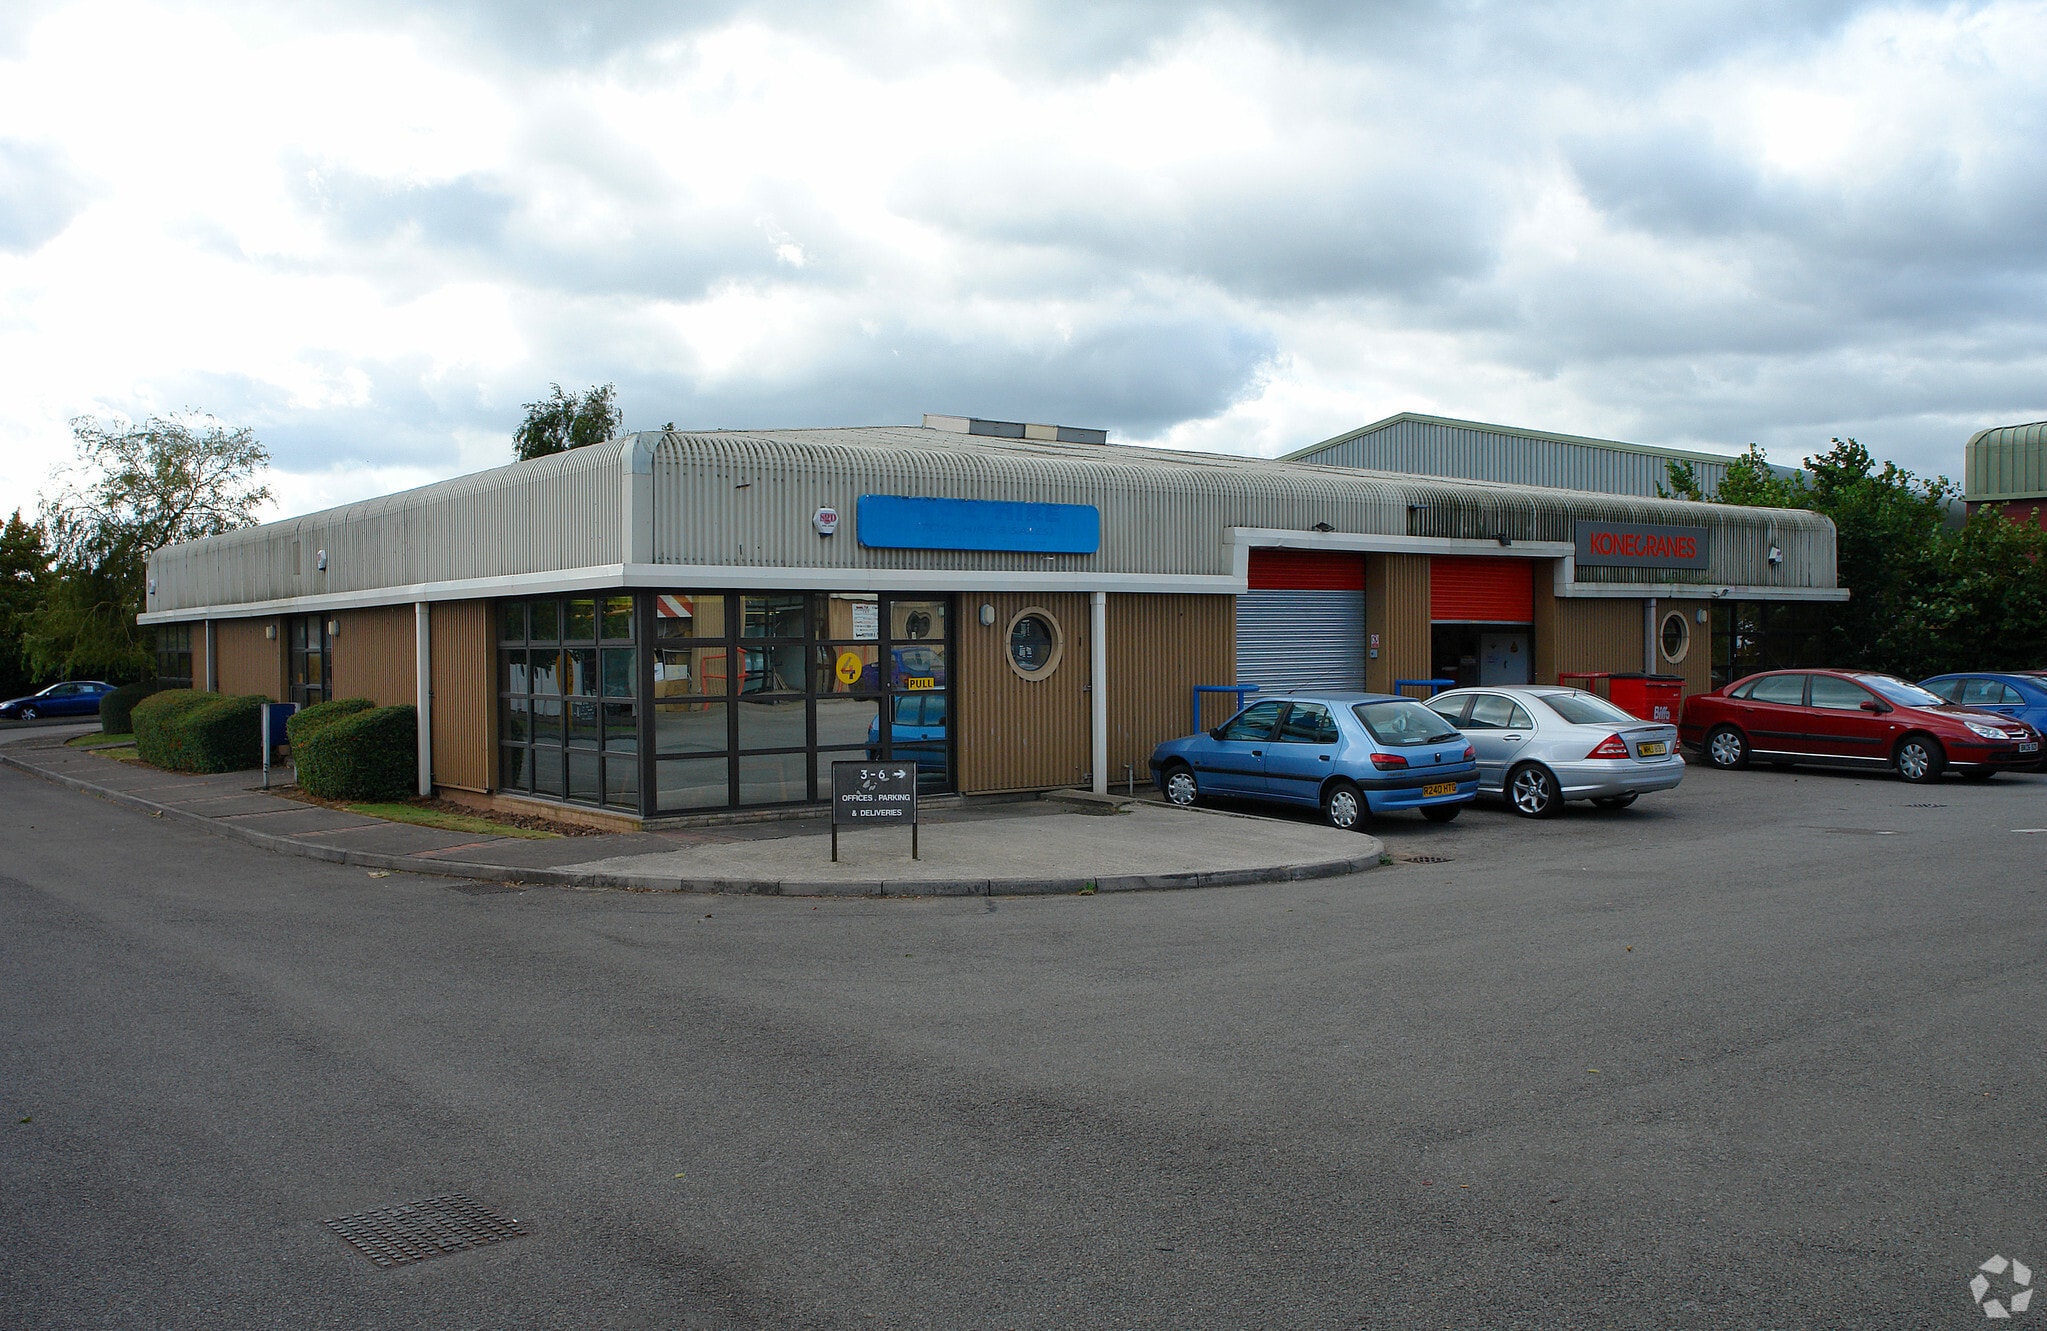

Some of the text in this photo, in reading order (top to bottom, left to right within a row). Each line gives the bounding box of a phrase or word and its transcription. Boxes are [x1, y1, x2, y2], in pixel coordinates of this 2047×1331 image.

[1590, 532, 1697, 559] KONECRANES
[909, 679, 934, 689] PULL
[1423, 785, 1443, 796] R240
[841, 794, 873, 802] OFFICES
[851, 809, 903, 817] & DELIVERIES
